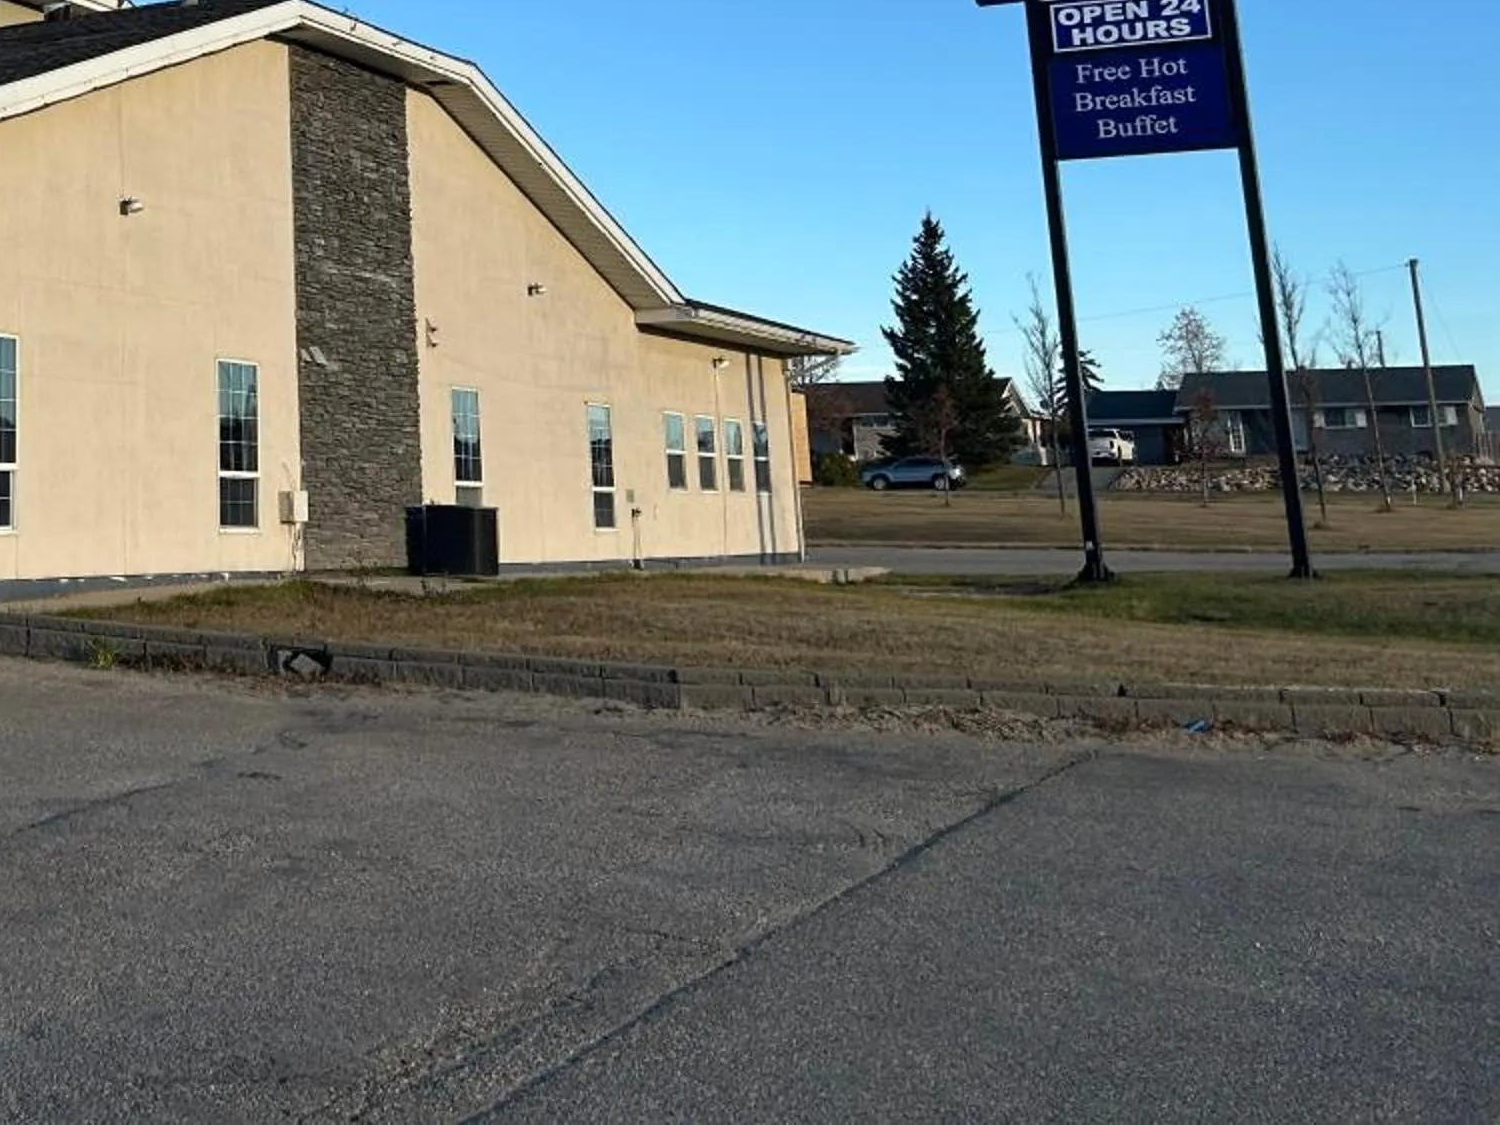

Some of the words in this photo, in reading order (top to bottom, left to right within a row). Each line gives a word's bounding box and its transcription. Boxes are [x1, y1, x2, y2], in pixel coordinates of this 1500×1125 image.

[1057, 0, 1149, 26] OPEN
[1071, 18, 1192, 46] HOURS
[1075, 63, 1132, 84] Free
[1139, 57, 1189, 79] Hot
[1074, 85, 1197, 112] Breakfast
[1096, 115, 1179, 139] Buffet
